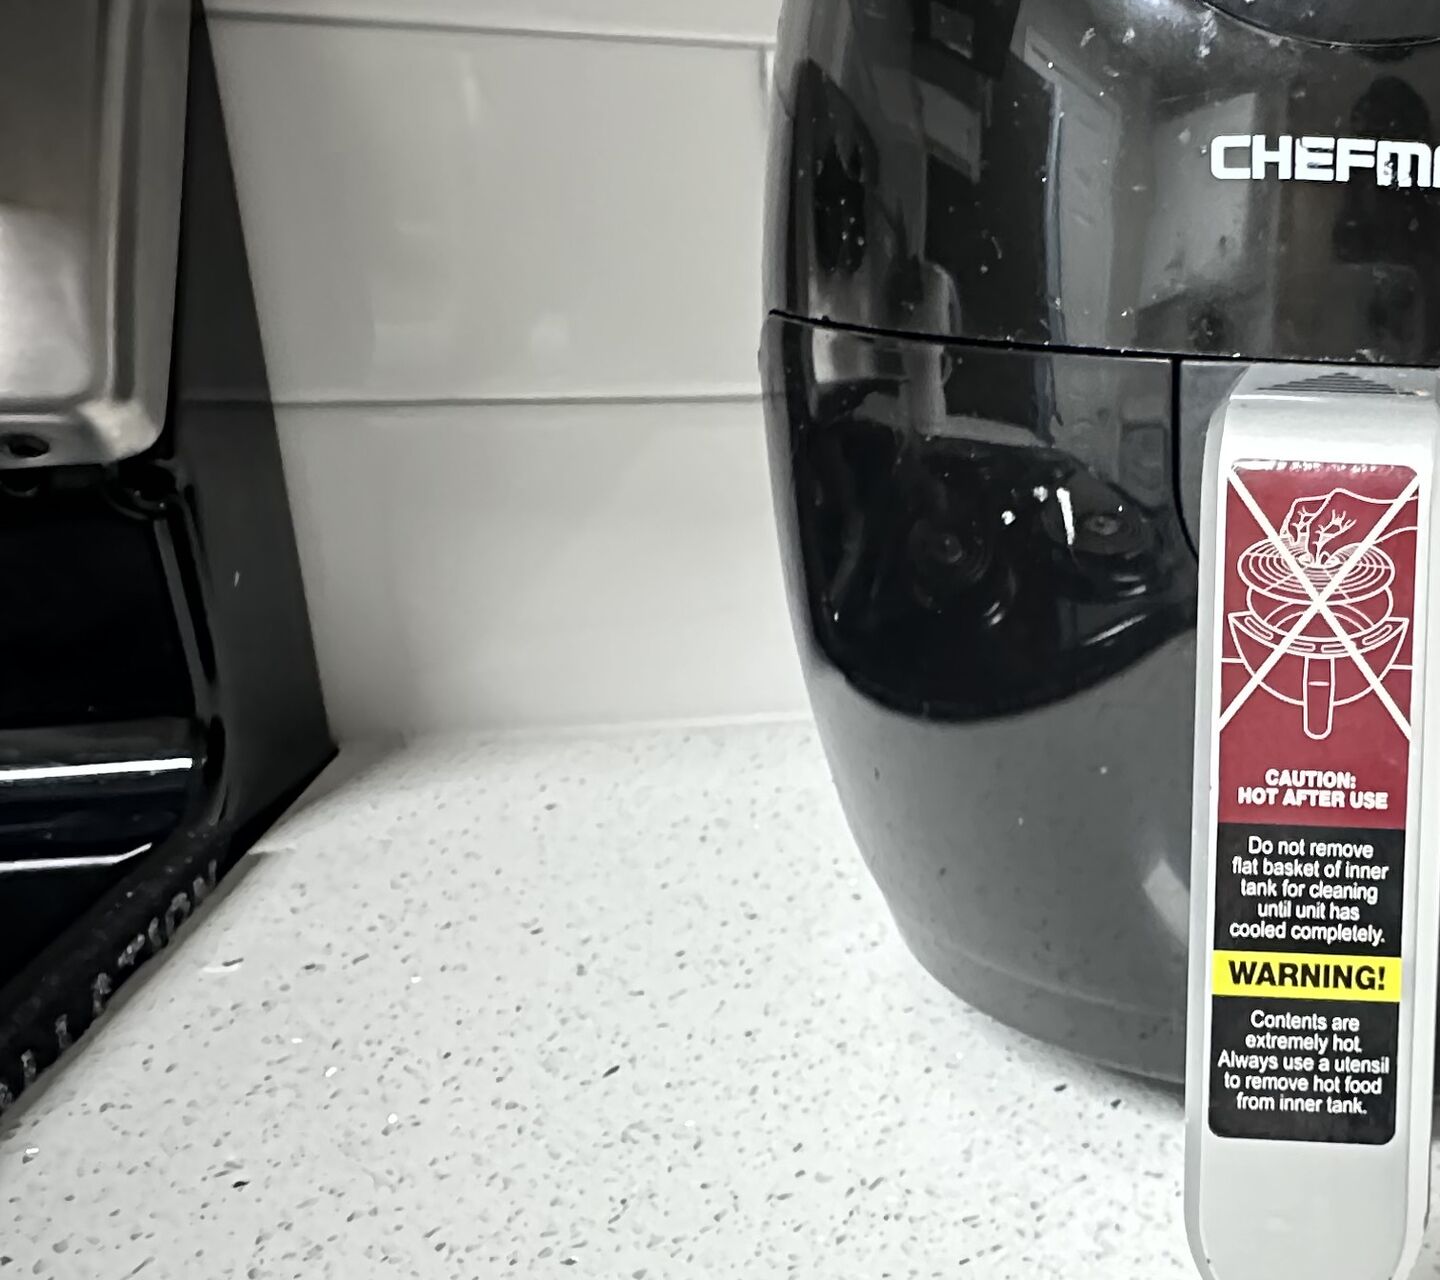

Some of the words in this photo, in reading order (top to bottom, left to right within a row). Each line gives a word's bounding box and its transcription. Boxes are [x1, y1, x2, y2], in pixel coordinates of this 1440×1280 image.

[1265, 768, 1356, 789] CAUTION:
[1237, 787, 1279, 806] HOT
[1282, 788, 1345, 808] AFTER
[1349, 791, 1389, 810] USE
[1248, 835, 1274, 855] Do
[1278, 837, 1306, 857] not
[1310, 840, 1374, 859] remove
[1232, 857, 1259, 876] flat
[1262, 858, 1320, 878] basket
[1323, 859, 1342, 879] of
[1345, 862, 1389, 880] inner
[1241, 878, 1277, 898] tank
[1281, 879, 1306, 898] for
[1309, 880, 1378, 905] cleaning
[1258, 900, 1292, 919] until
[1295, 901, 1327, 920] unit
[1330, 903, 1360, 921] has
[1229, 920, 1287, 939] cooled
[1290, 923, 1385, 947] completely.
[1228, 959, 1385, 991] WARNING!
[1250, 1009, 1327, 1031] Contents
[1331, 1015, 1360, 1032] are
[1245, 1032, 1329, 1054] extremely
[1217, 1050, 1279, 1073] Always
[1283, 1055, 1314, 1071] use
[1318, 1057, 1330, 1072] a
[1334, 1056, 1390, 1074] utensil
[1224, 1072, 1241, 1090] to
[1245, 1075, 1309, 1092] remove
[1313, 1075, 1340, 1094] hot
[1344, 1076, 1382, 1095] food
[1236, 1091, 1275, 1112] from
[1279, 1093, 1322, 1113] inner
[1326, 1095, 1367, 1114] tank.
